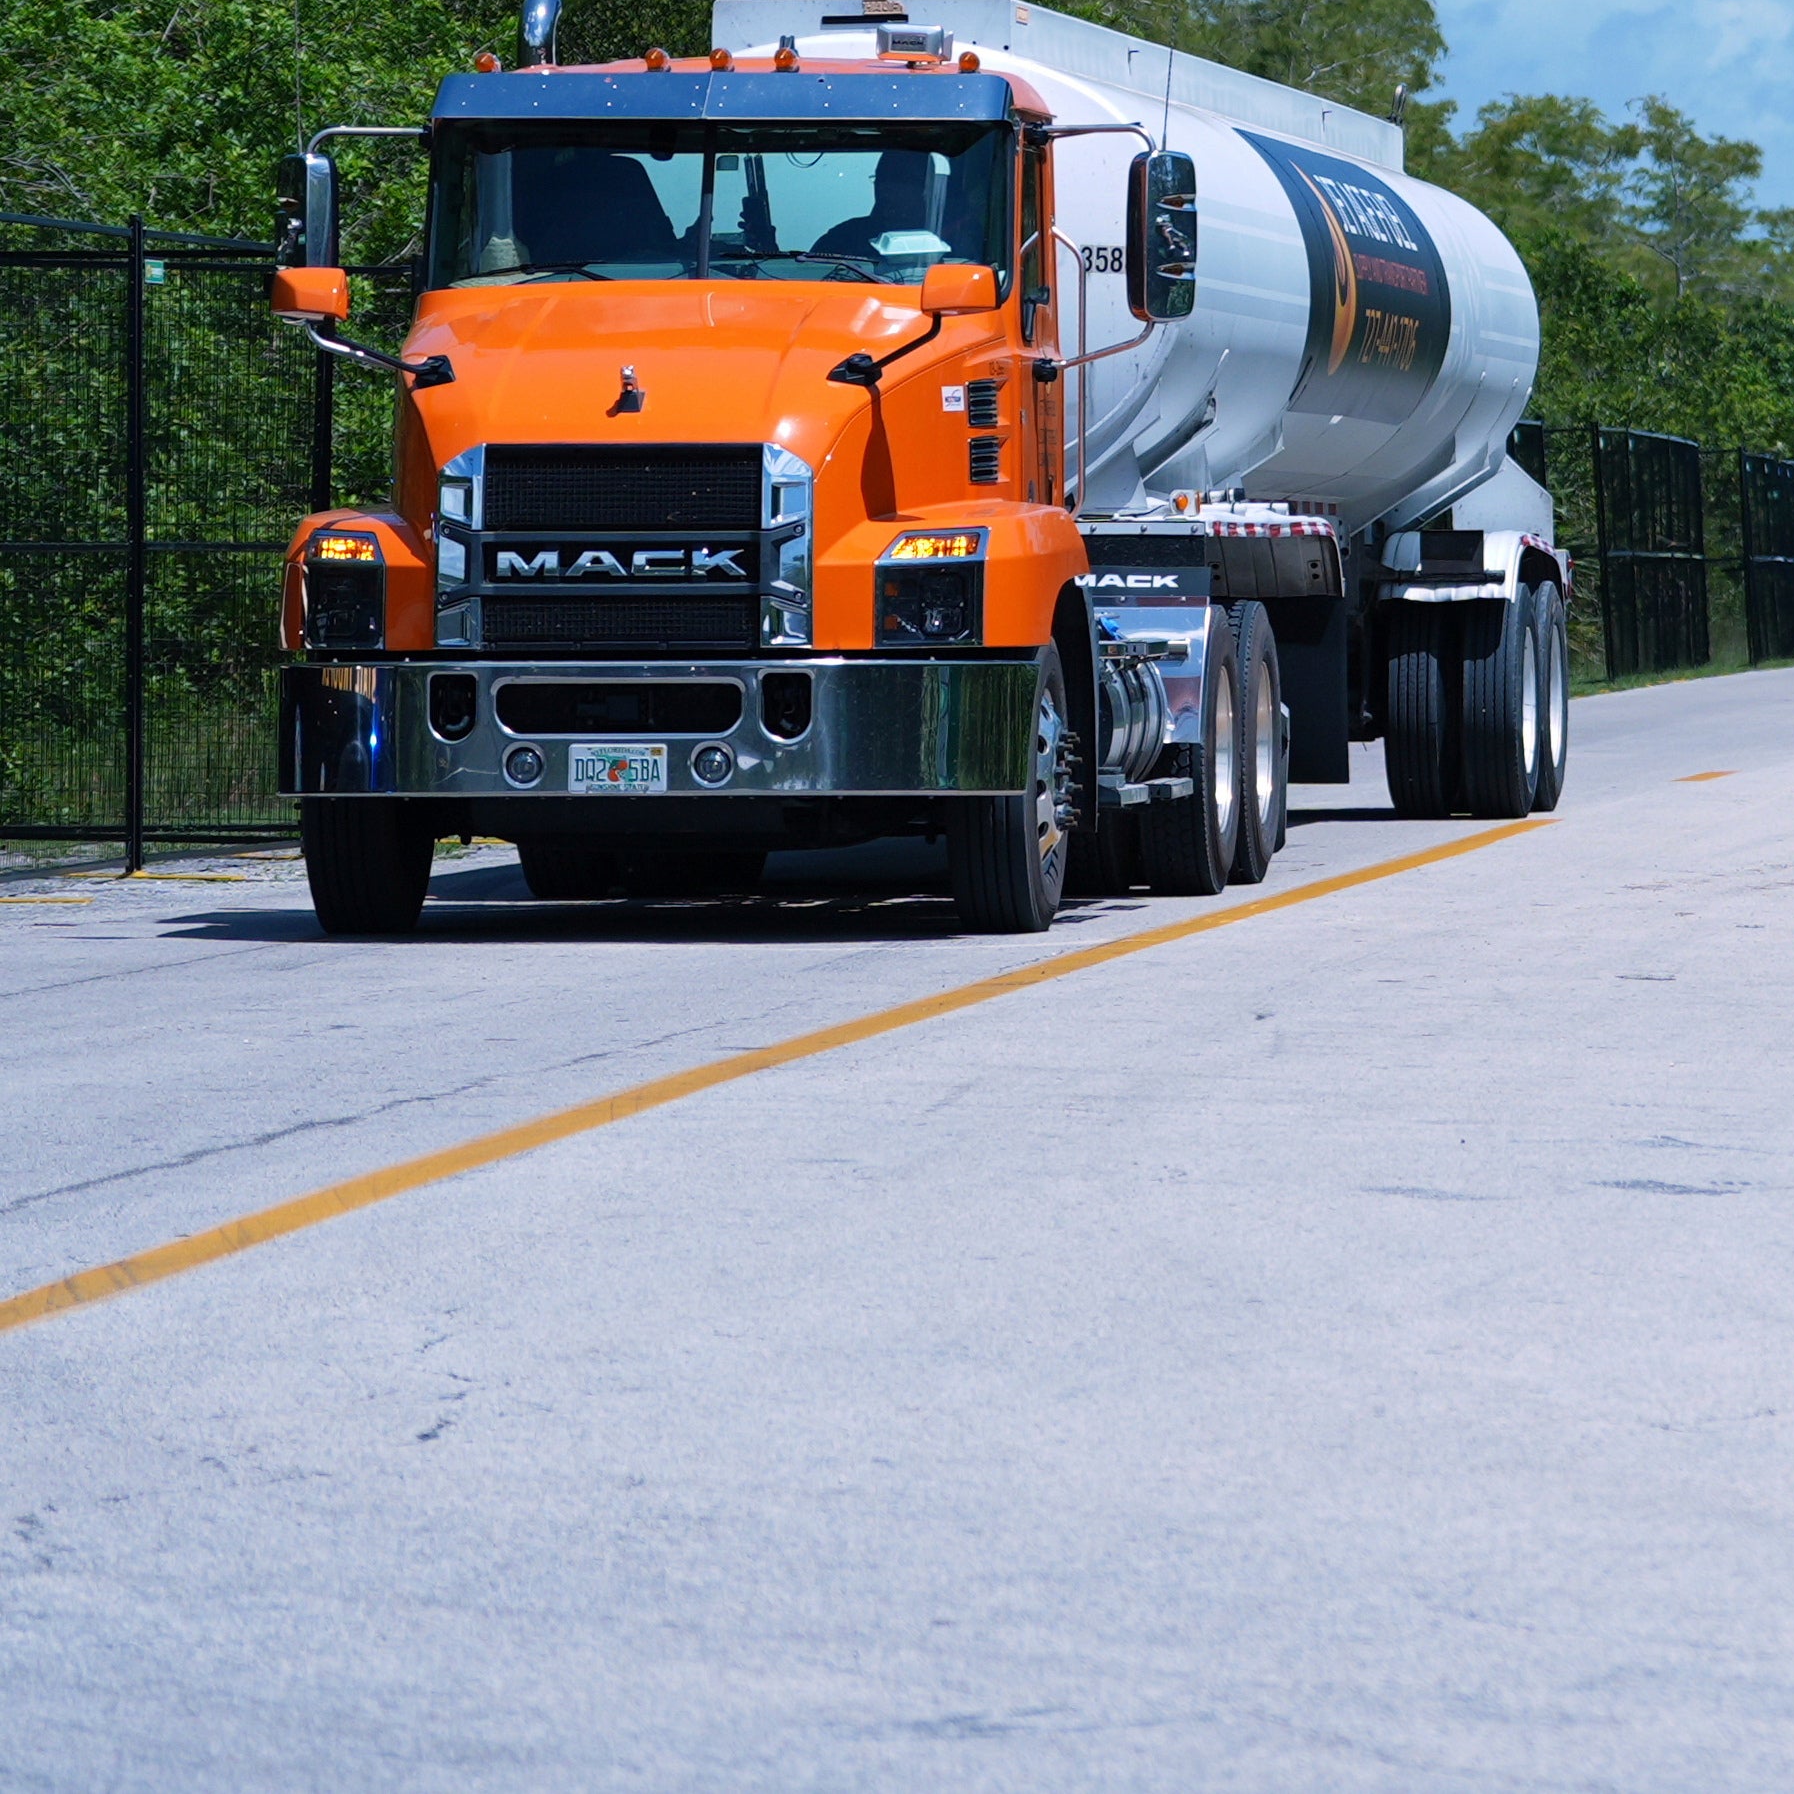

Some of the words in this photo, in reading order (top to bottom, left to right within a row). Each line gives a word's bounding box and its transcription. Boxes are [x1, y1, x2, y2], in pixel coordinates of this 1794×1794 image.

[1081, 246, 1123, 273] 358
[496, 548, 747, 577] MACK
[1073, 573, 1179, 588] MACK
